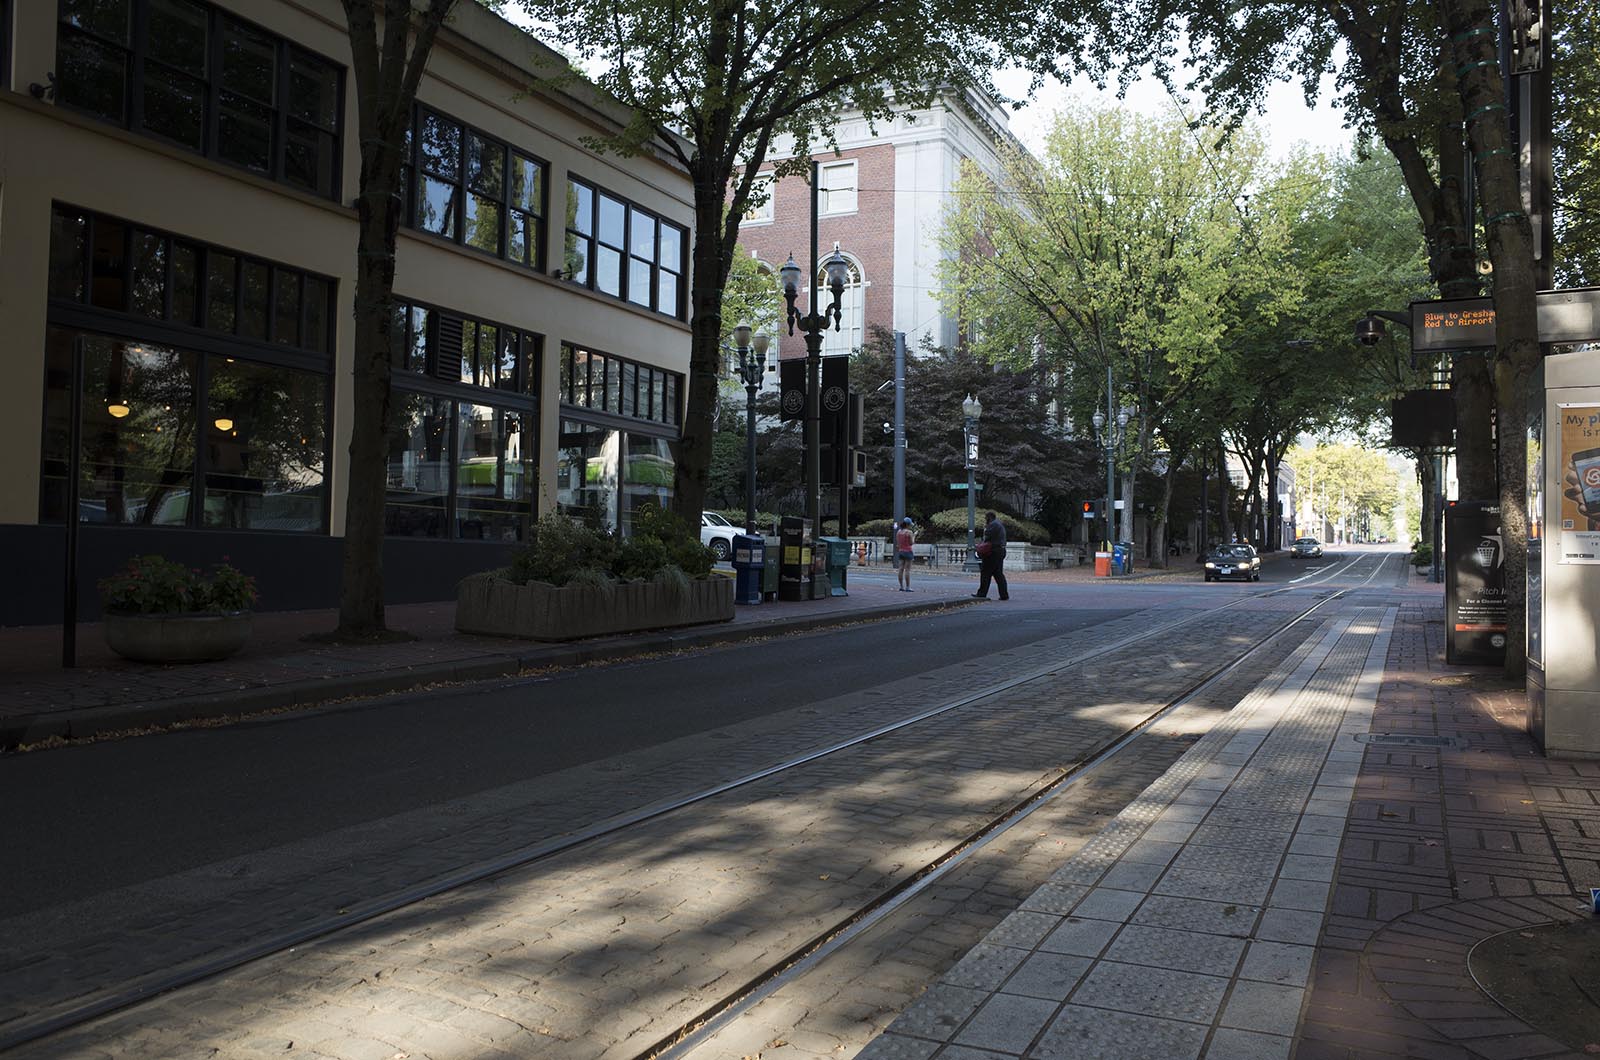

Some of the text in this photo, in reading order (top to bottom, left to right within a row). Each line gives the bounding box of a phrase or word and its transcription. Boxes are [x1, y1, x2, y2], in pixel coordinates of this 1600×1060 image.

[1424, 313, 1444, 321] Blue
[1424, 317, 1493, 328] Red to Airport
[1566, 415, 1585, 427] My
[1583, 427, 1592, 437] is
